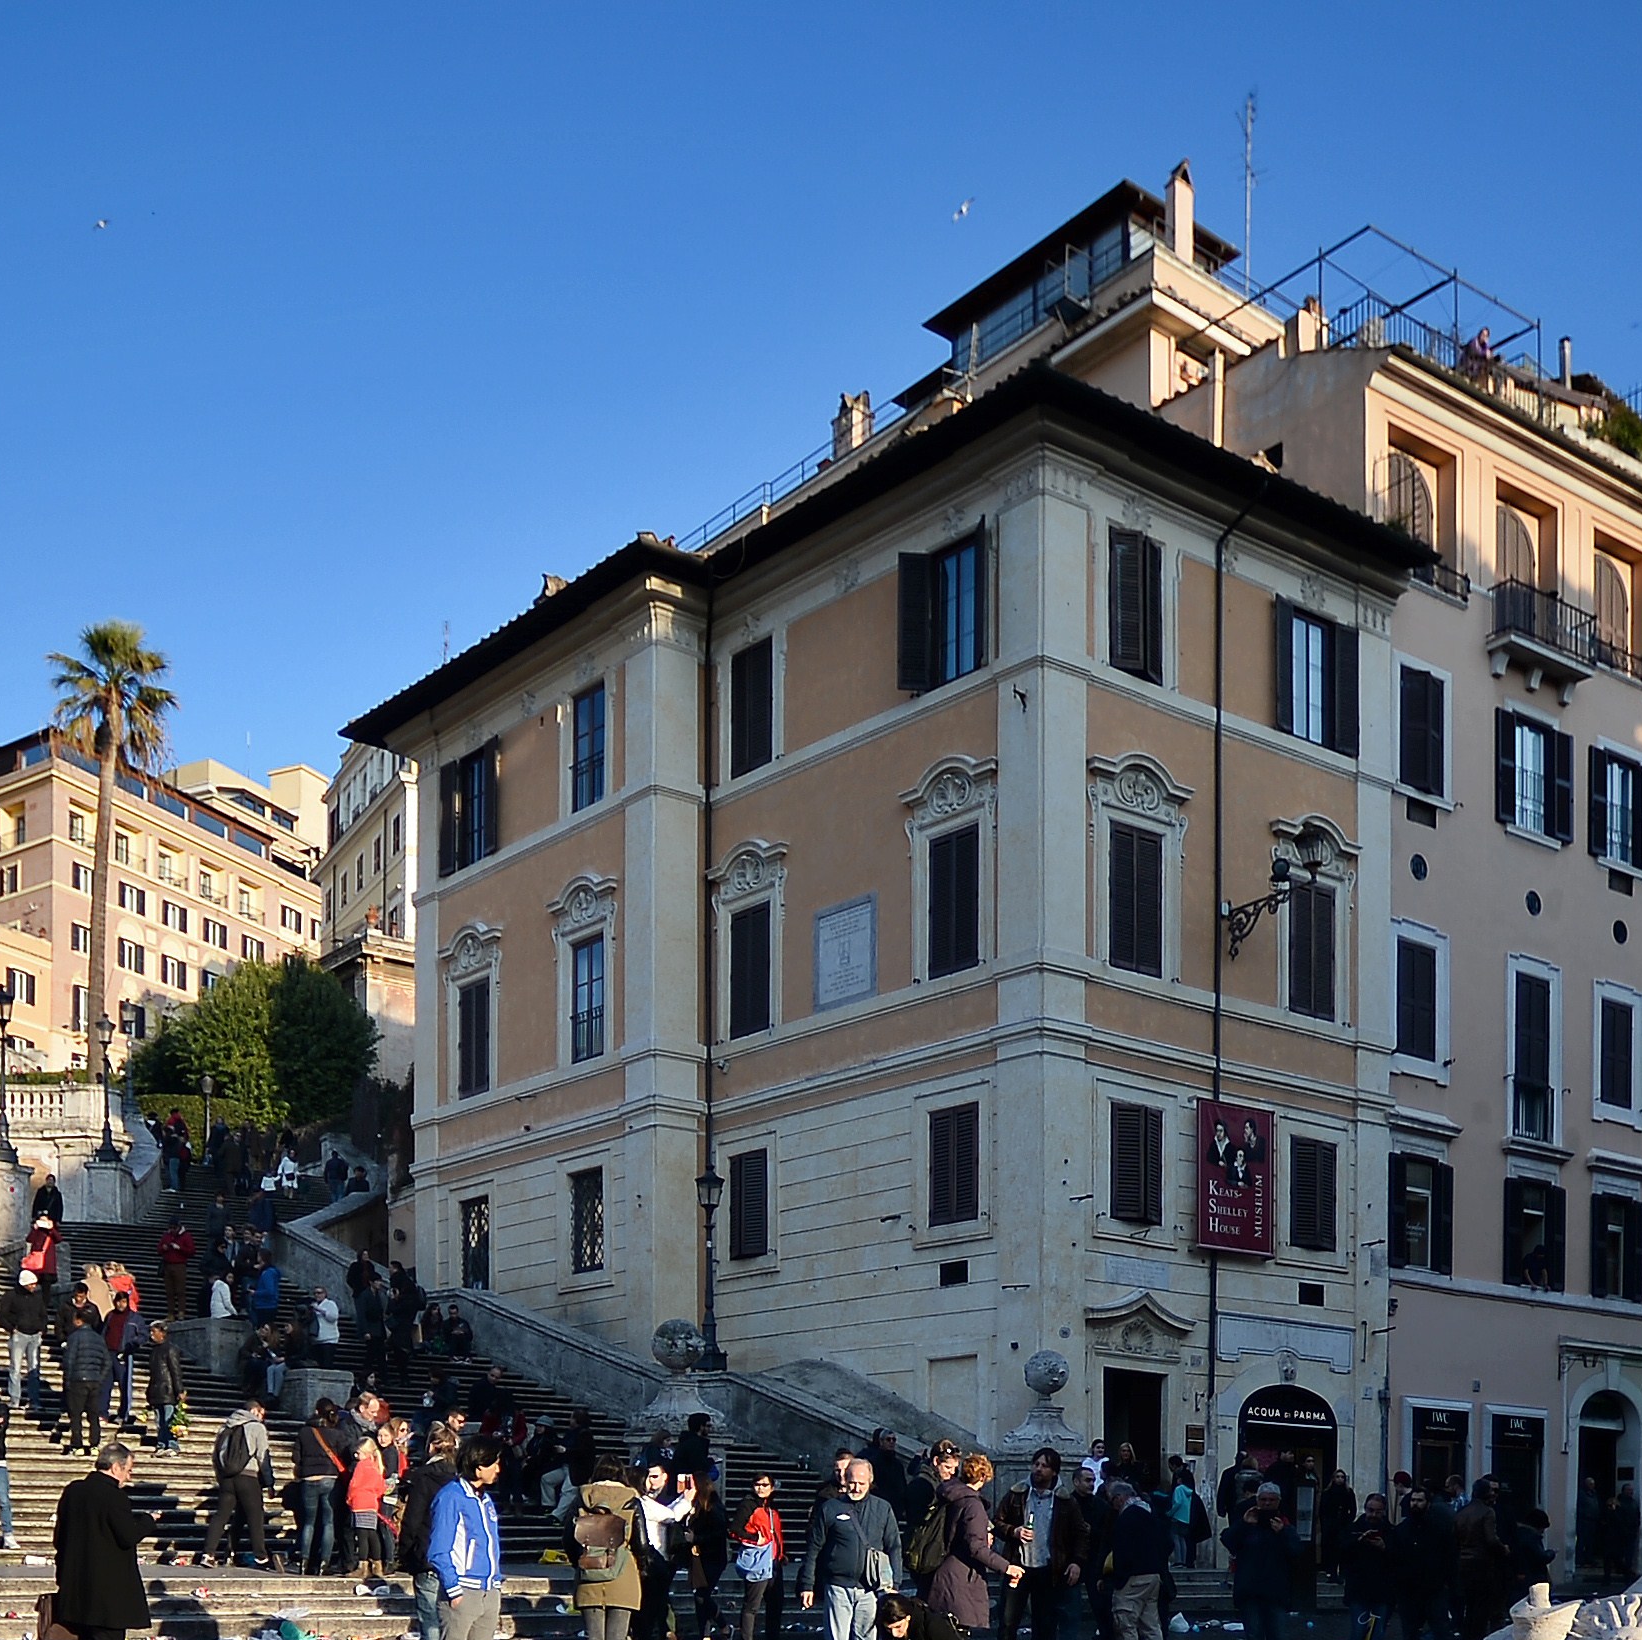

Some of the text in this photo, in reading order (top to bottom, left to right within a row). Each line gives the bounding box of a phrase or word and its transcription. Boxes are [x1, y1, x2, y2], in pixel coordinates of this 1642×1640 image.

[1254, 1174, 1263, 1238] MUSEUM
[1247, 1406, 1281, 1417] ACQUA
[1293, 1409, 1327, 1421] PARMA
[1432, 1411, 1450, 1424] IWC
[1509, 1418, 1527, 1431] IWC
